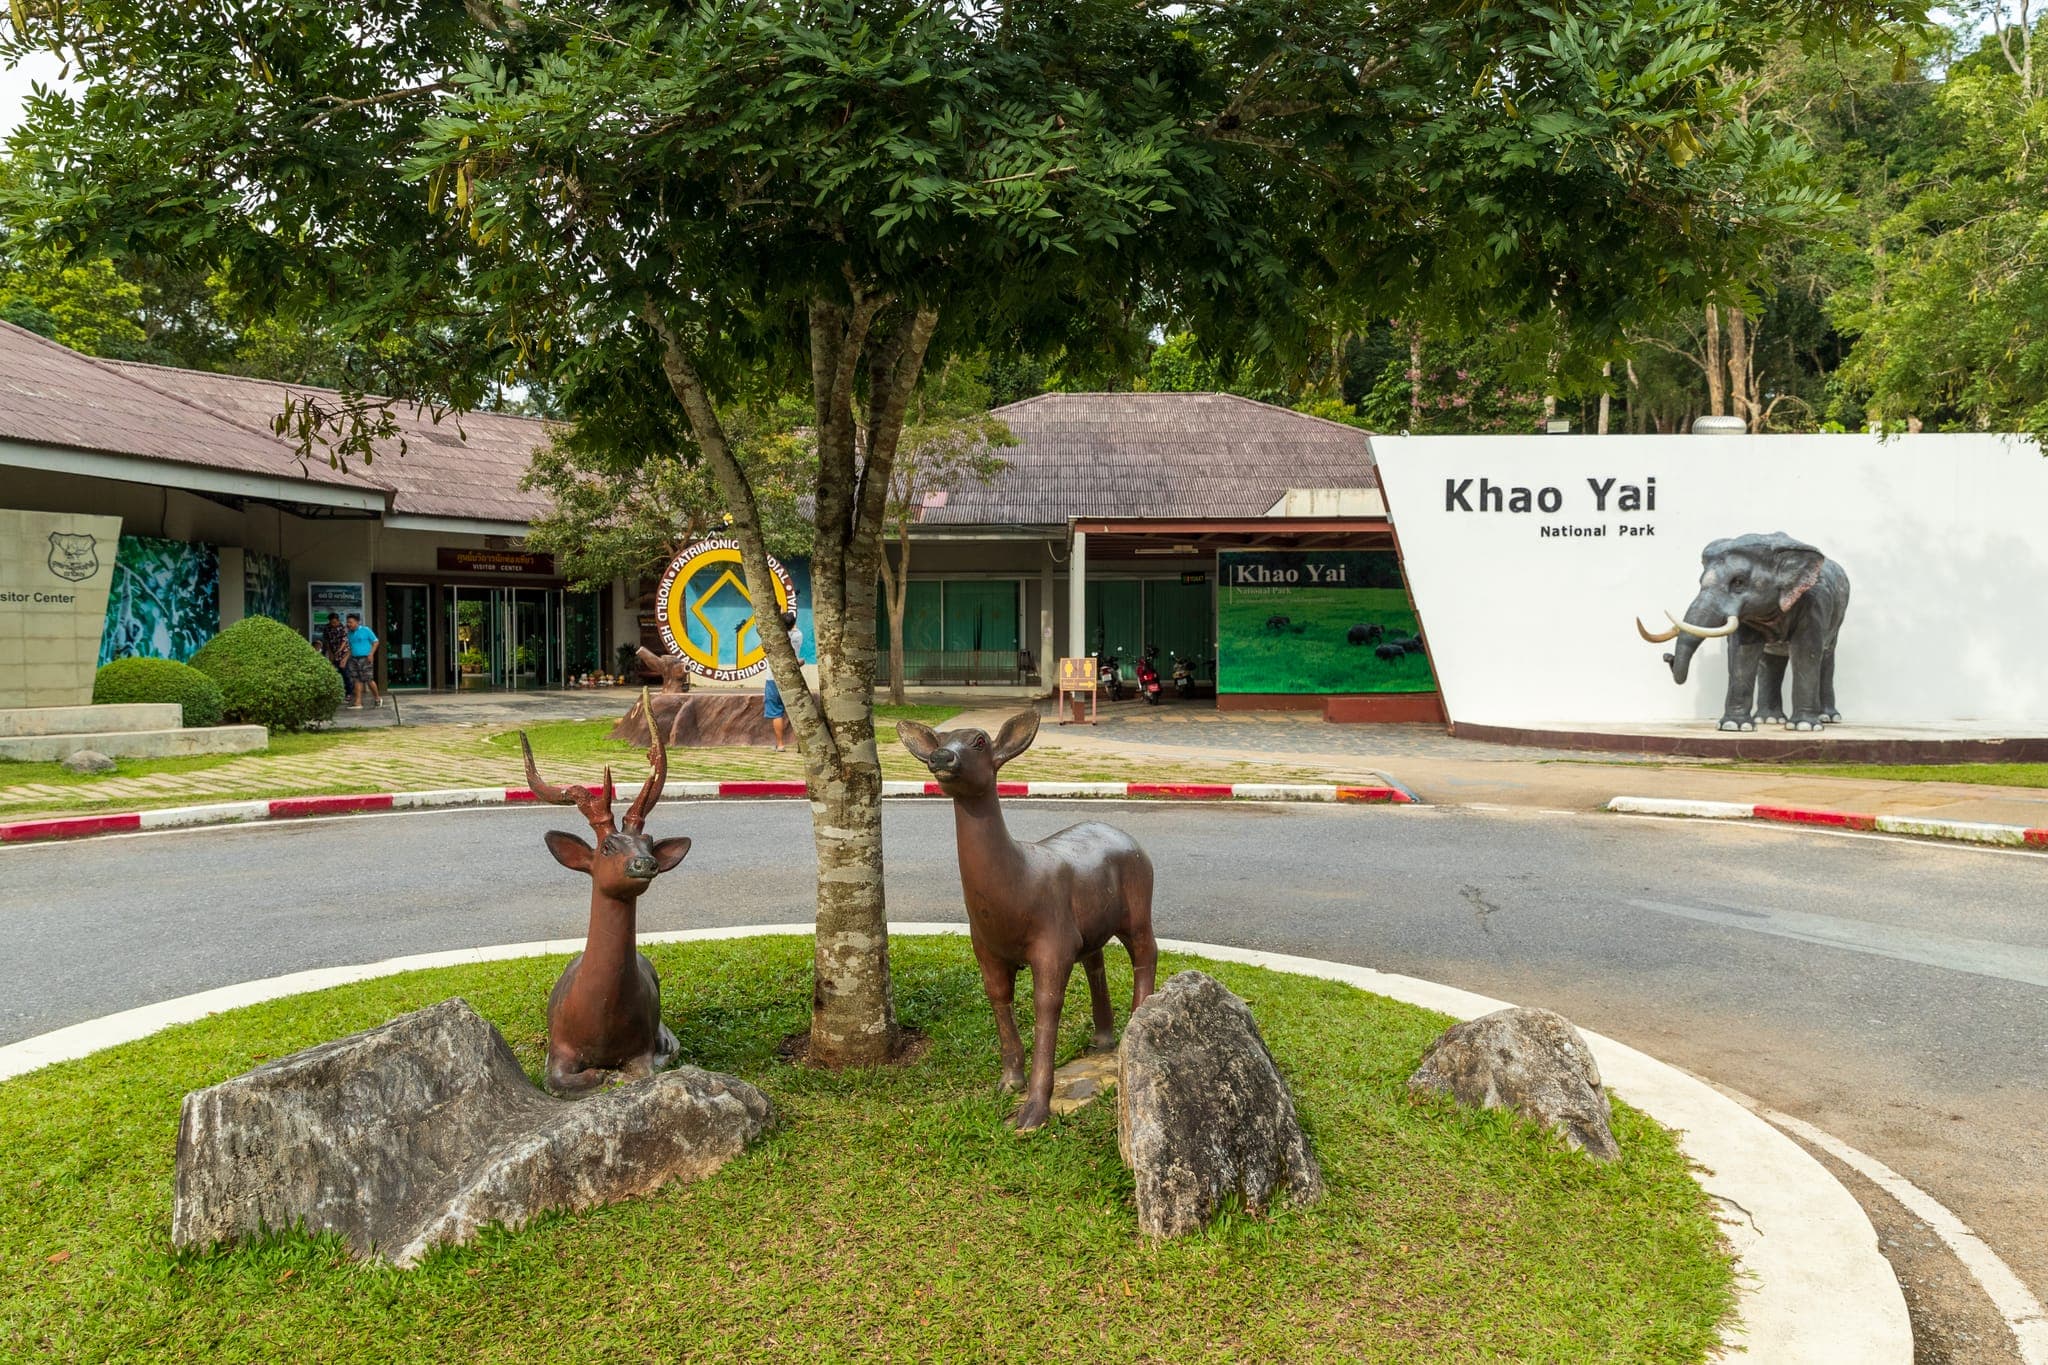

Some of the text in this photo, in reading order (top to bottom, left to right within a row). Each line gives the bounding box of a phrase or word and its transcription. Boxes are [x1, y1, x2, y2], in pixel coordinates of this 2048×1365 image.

[1445, 477, 1656, 513] Khao Yai
[1541, 524, 1655, 537] National Park
[473, 563, 523, 572] VISITOR CENTER
[671, 539, 789, 584] PATRIMONIO DIAL
[1236, 564, 1346, 583] Khao Yai
[0, 592, 77, 603] sitor Center
[1237, 586, 1292, 595] National Park
[657, 578, 705, 675] WORLD HERITAGE
[714, 656, 769, 680] PATRIMO
